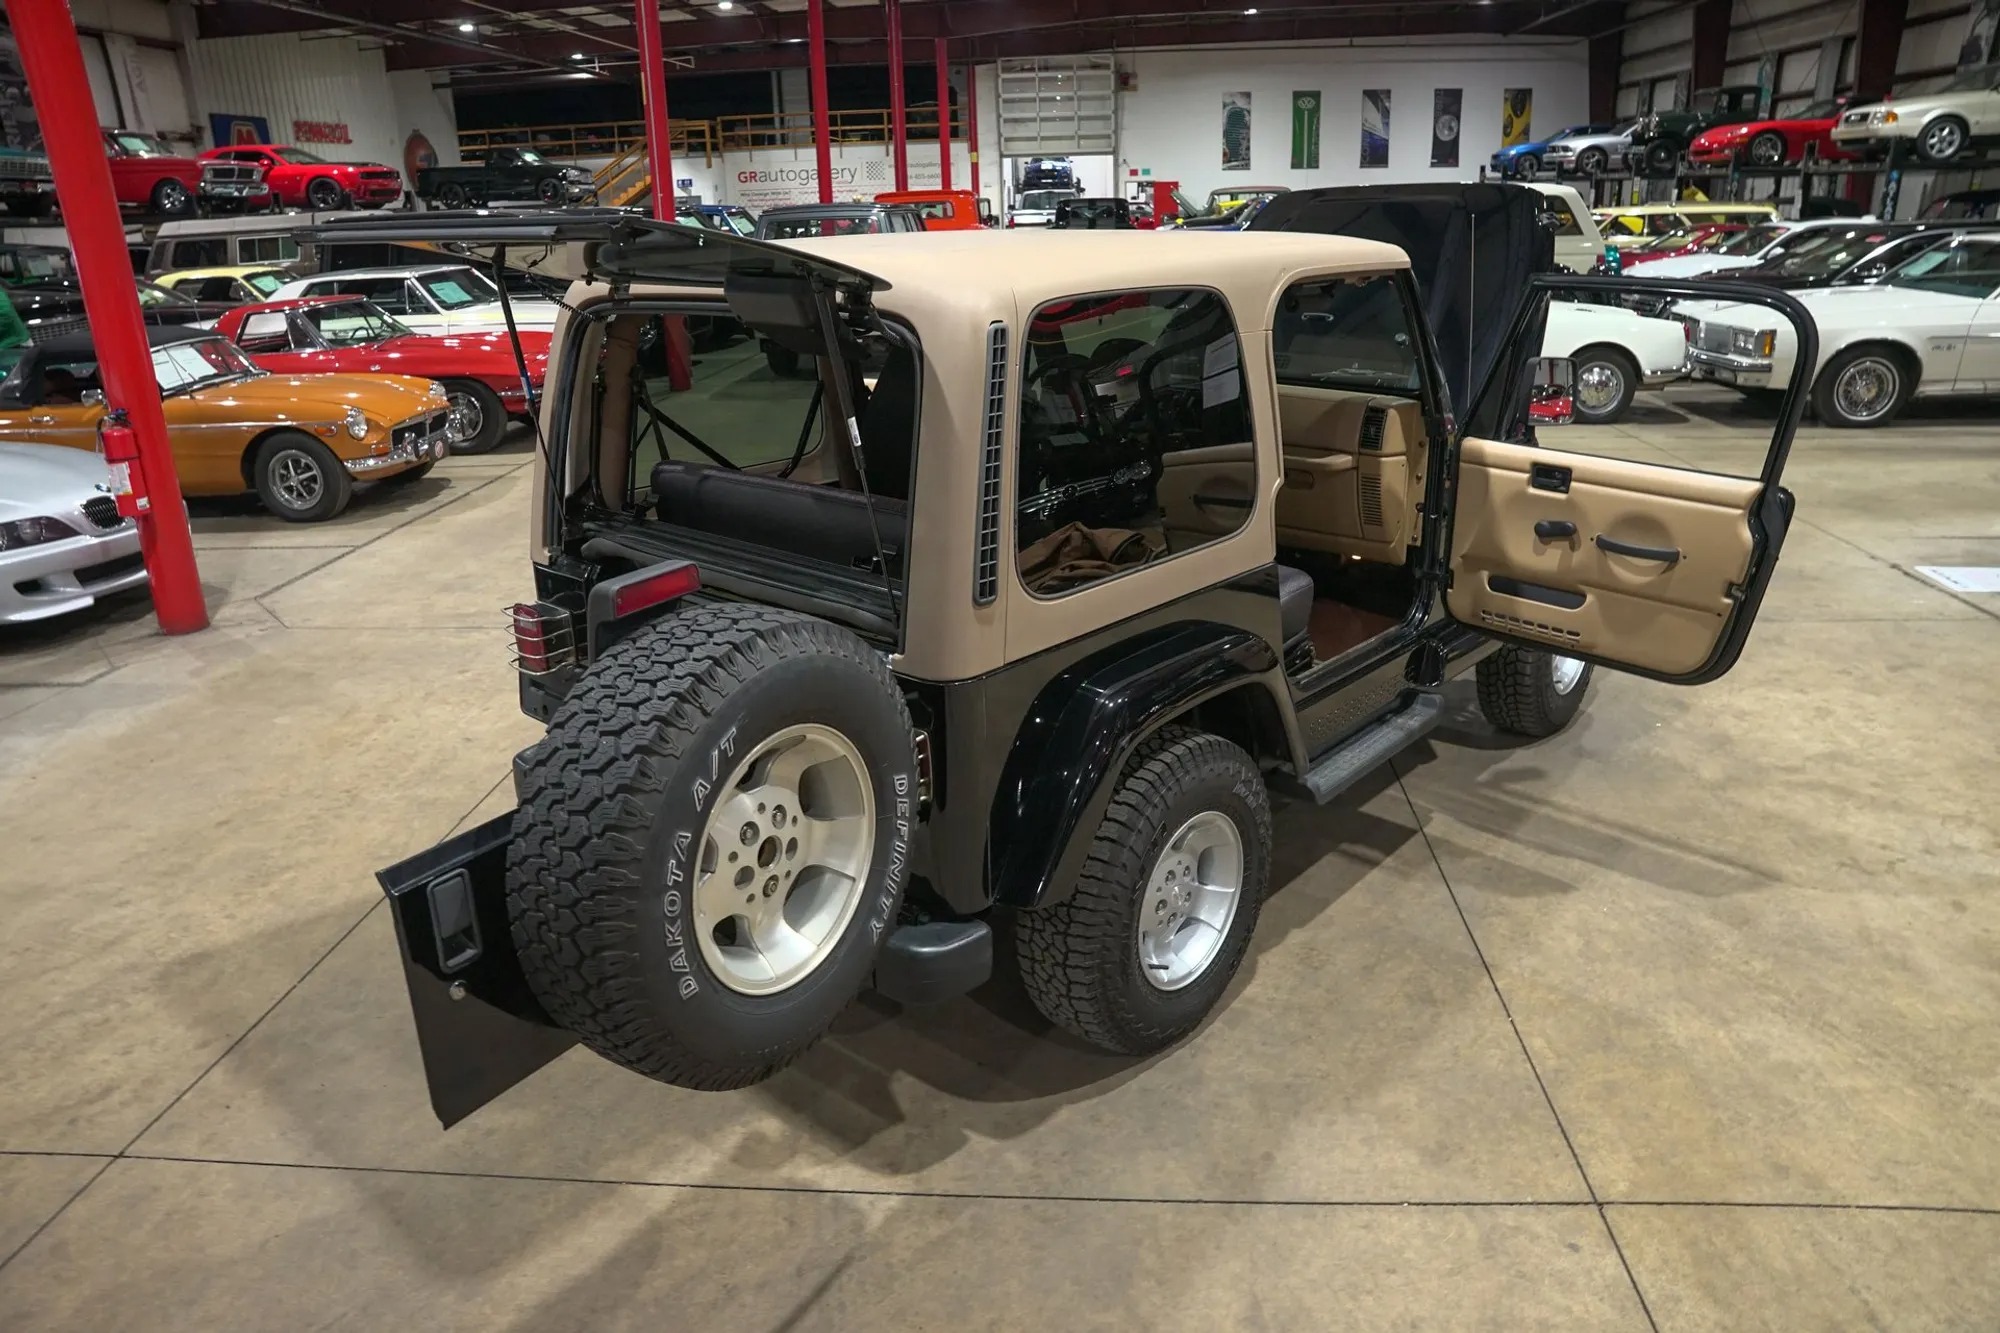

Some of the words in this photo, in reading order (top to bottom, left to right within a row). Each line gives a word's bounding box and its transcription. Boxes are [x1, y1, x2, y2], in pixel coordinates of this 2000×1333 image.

[737, 167, 858, 186] GRautogaery
[664, 831, 699, 1000] DAKOTA
[692, 727, 737, 812] A/T
[869, 774, 910, 945] DEFINITY
